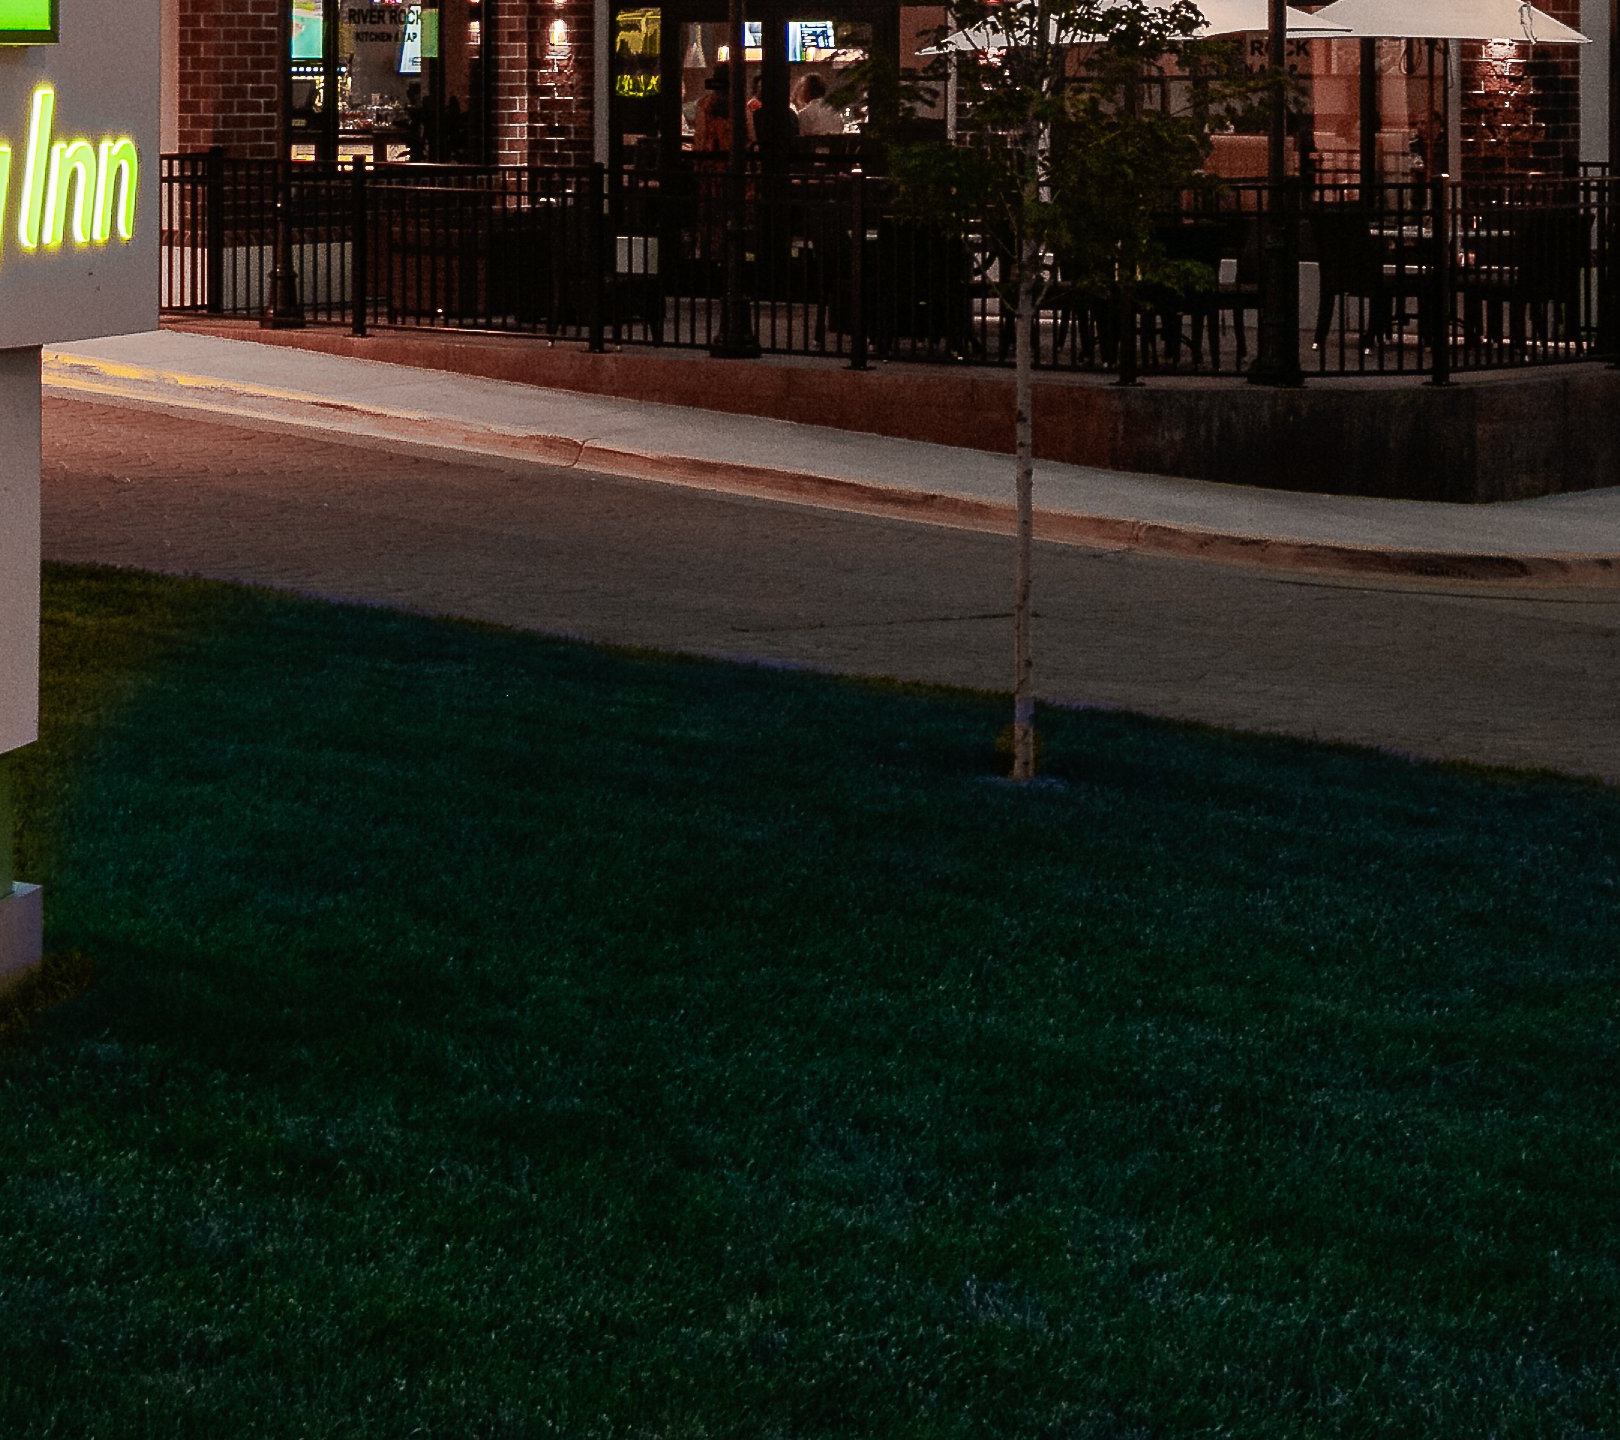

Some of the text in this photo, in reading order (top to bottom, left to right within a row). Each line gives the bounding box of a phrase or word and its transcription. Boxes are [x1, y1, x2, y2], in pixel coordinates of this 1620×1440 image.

[348, 8, 385, 25] RIVER
[355, 32, 392, 42] KITCHEN
[21, 88, 138, 248] Inn
